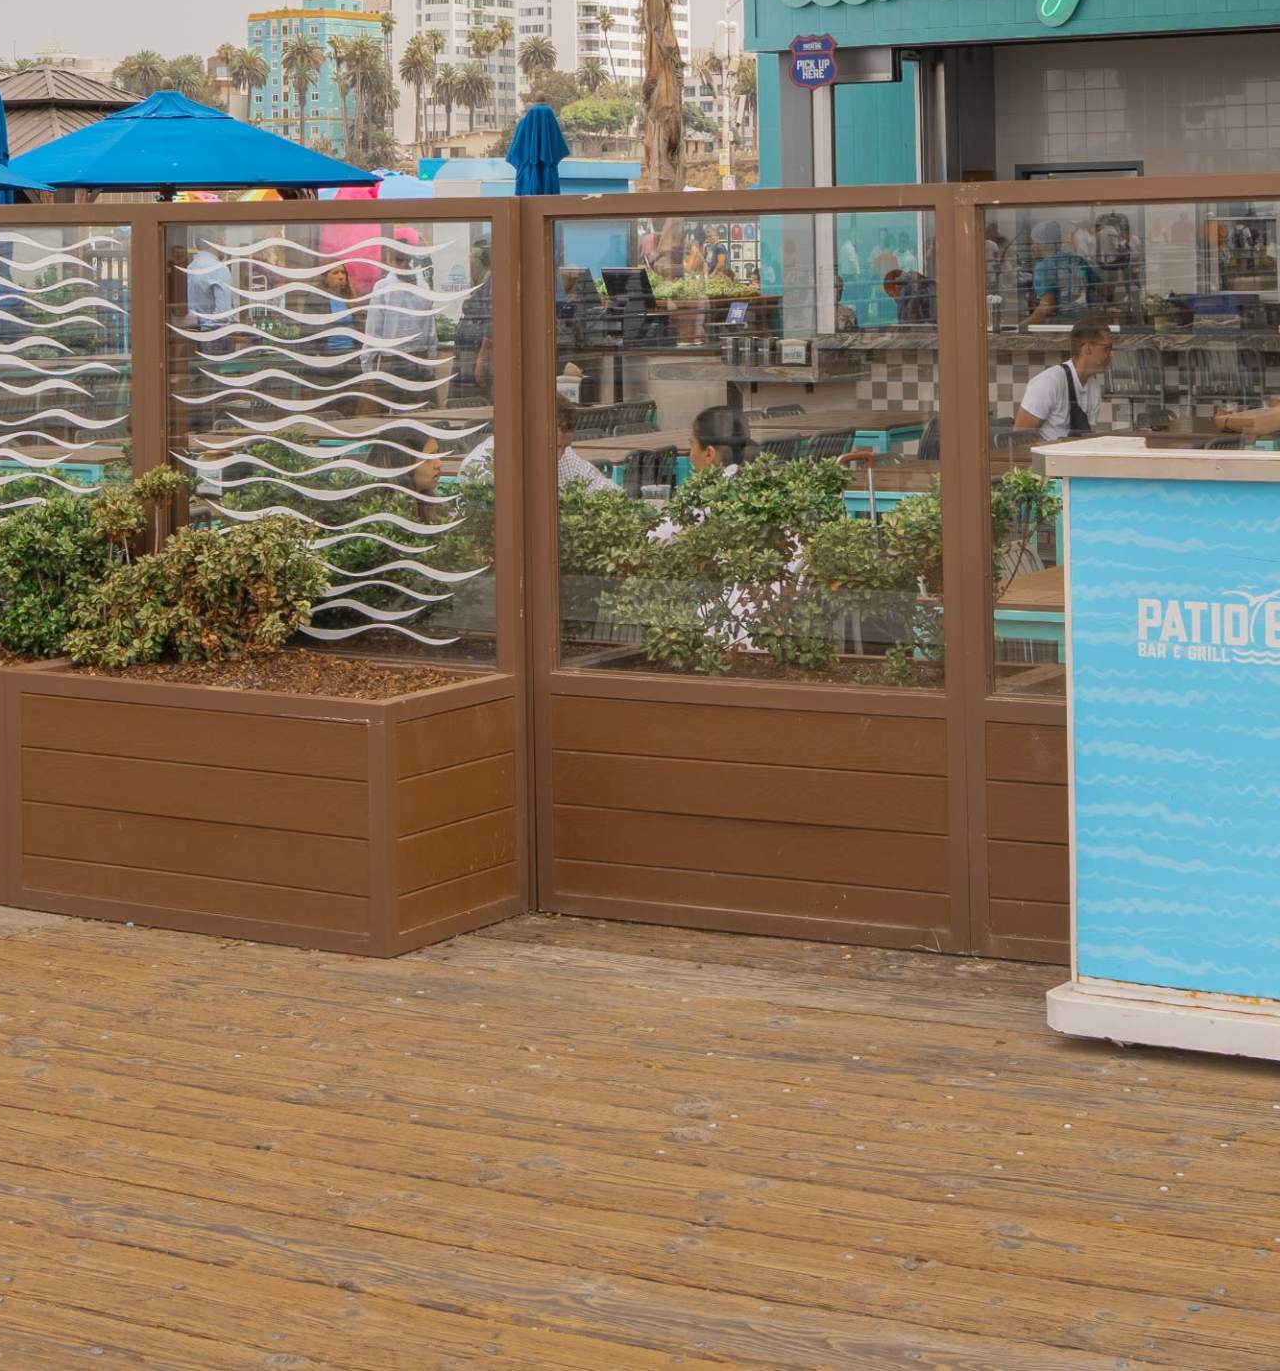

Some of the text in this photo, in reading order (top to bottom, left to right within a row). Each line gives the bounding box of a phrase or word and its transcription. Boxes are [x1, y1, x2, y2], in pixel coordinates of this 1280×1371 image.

[796, 58, 830, 70] PICK UP
[802, 69, 825, 79] HERE
[1137, 598, 1249, 646] PATIO
[1137, 641, 1167, 658] BAR
[1186, 645, 1231, 663] GRILL
